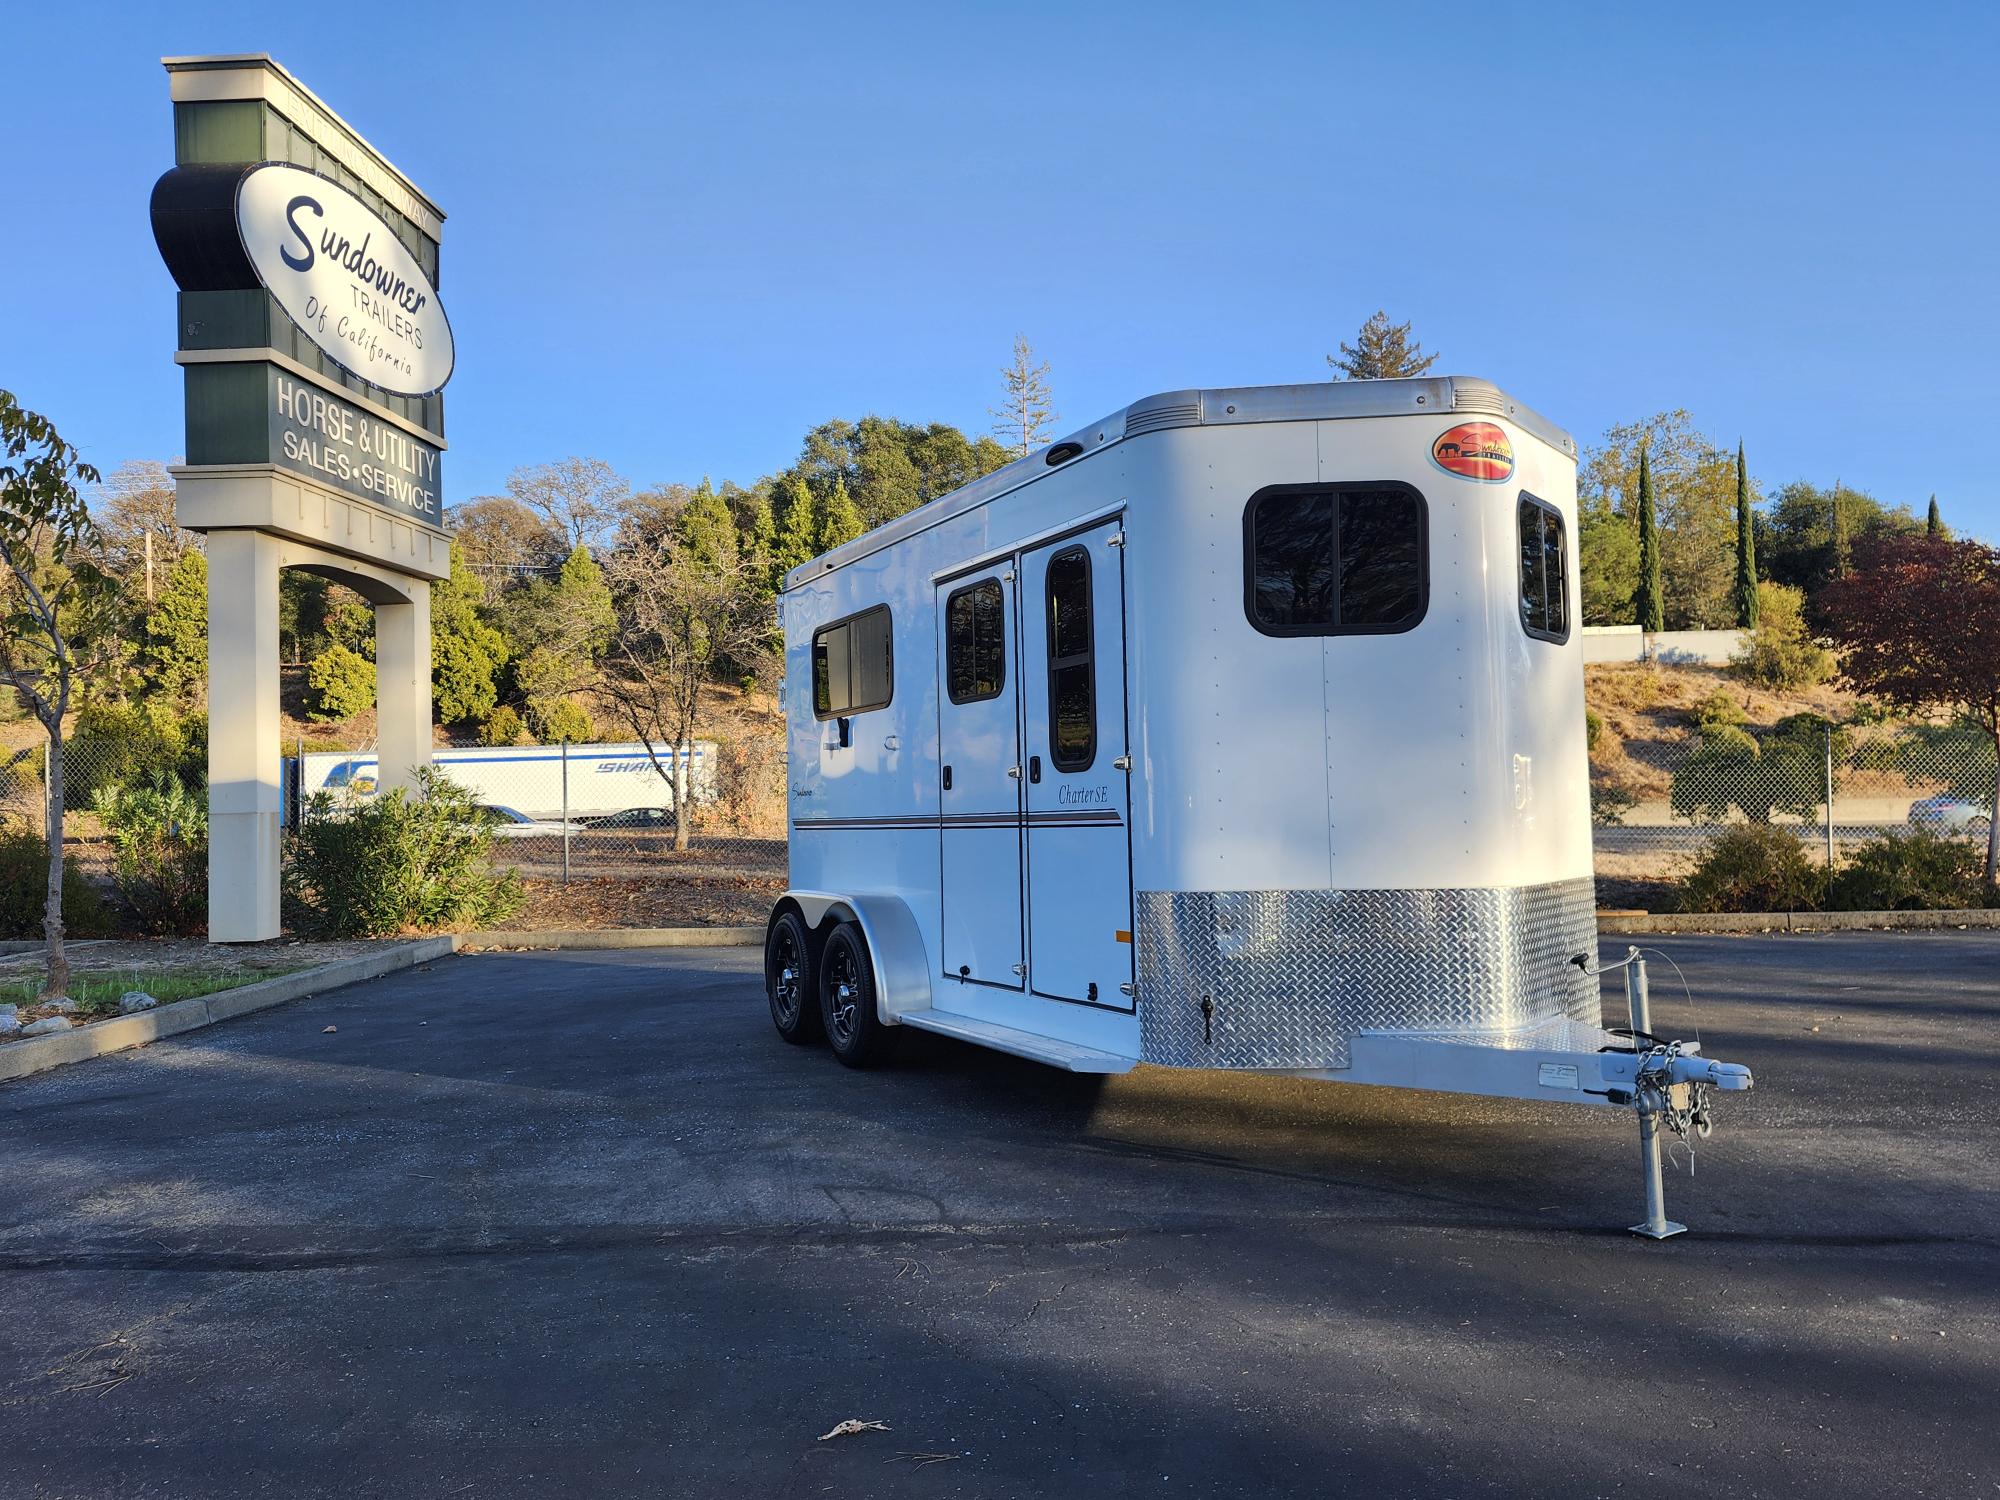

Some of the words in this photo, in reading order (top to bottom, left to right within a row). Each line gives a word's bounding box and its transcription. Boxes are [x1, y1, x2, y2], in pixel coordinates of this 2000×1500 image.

[400, 188, 428, 229] WAY
[280, 195, 427, 315] Sundowner
[306, 296, 328, 333] Of
[337, 316, 412, 377] California
[351, 284, 423, 350] TRAILERS
[277, 377, 354, 446] HORSE
[359, 418, 372, 453] &
[375, 426, 435, 482] UTILITY
[361, 463, 434, 515] SERVICE
[1059, 784, 1094, 804] Charter
[1095, 786, 1108, 803] SE
